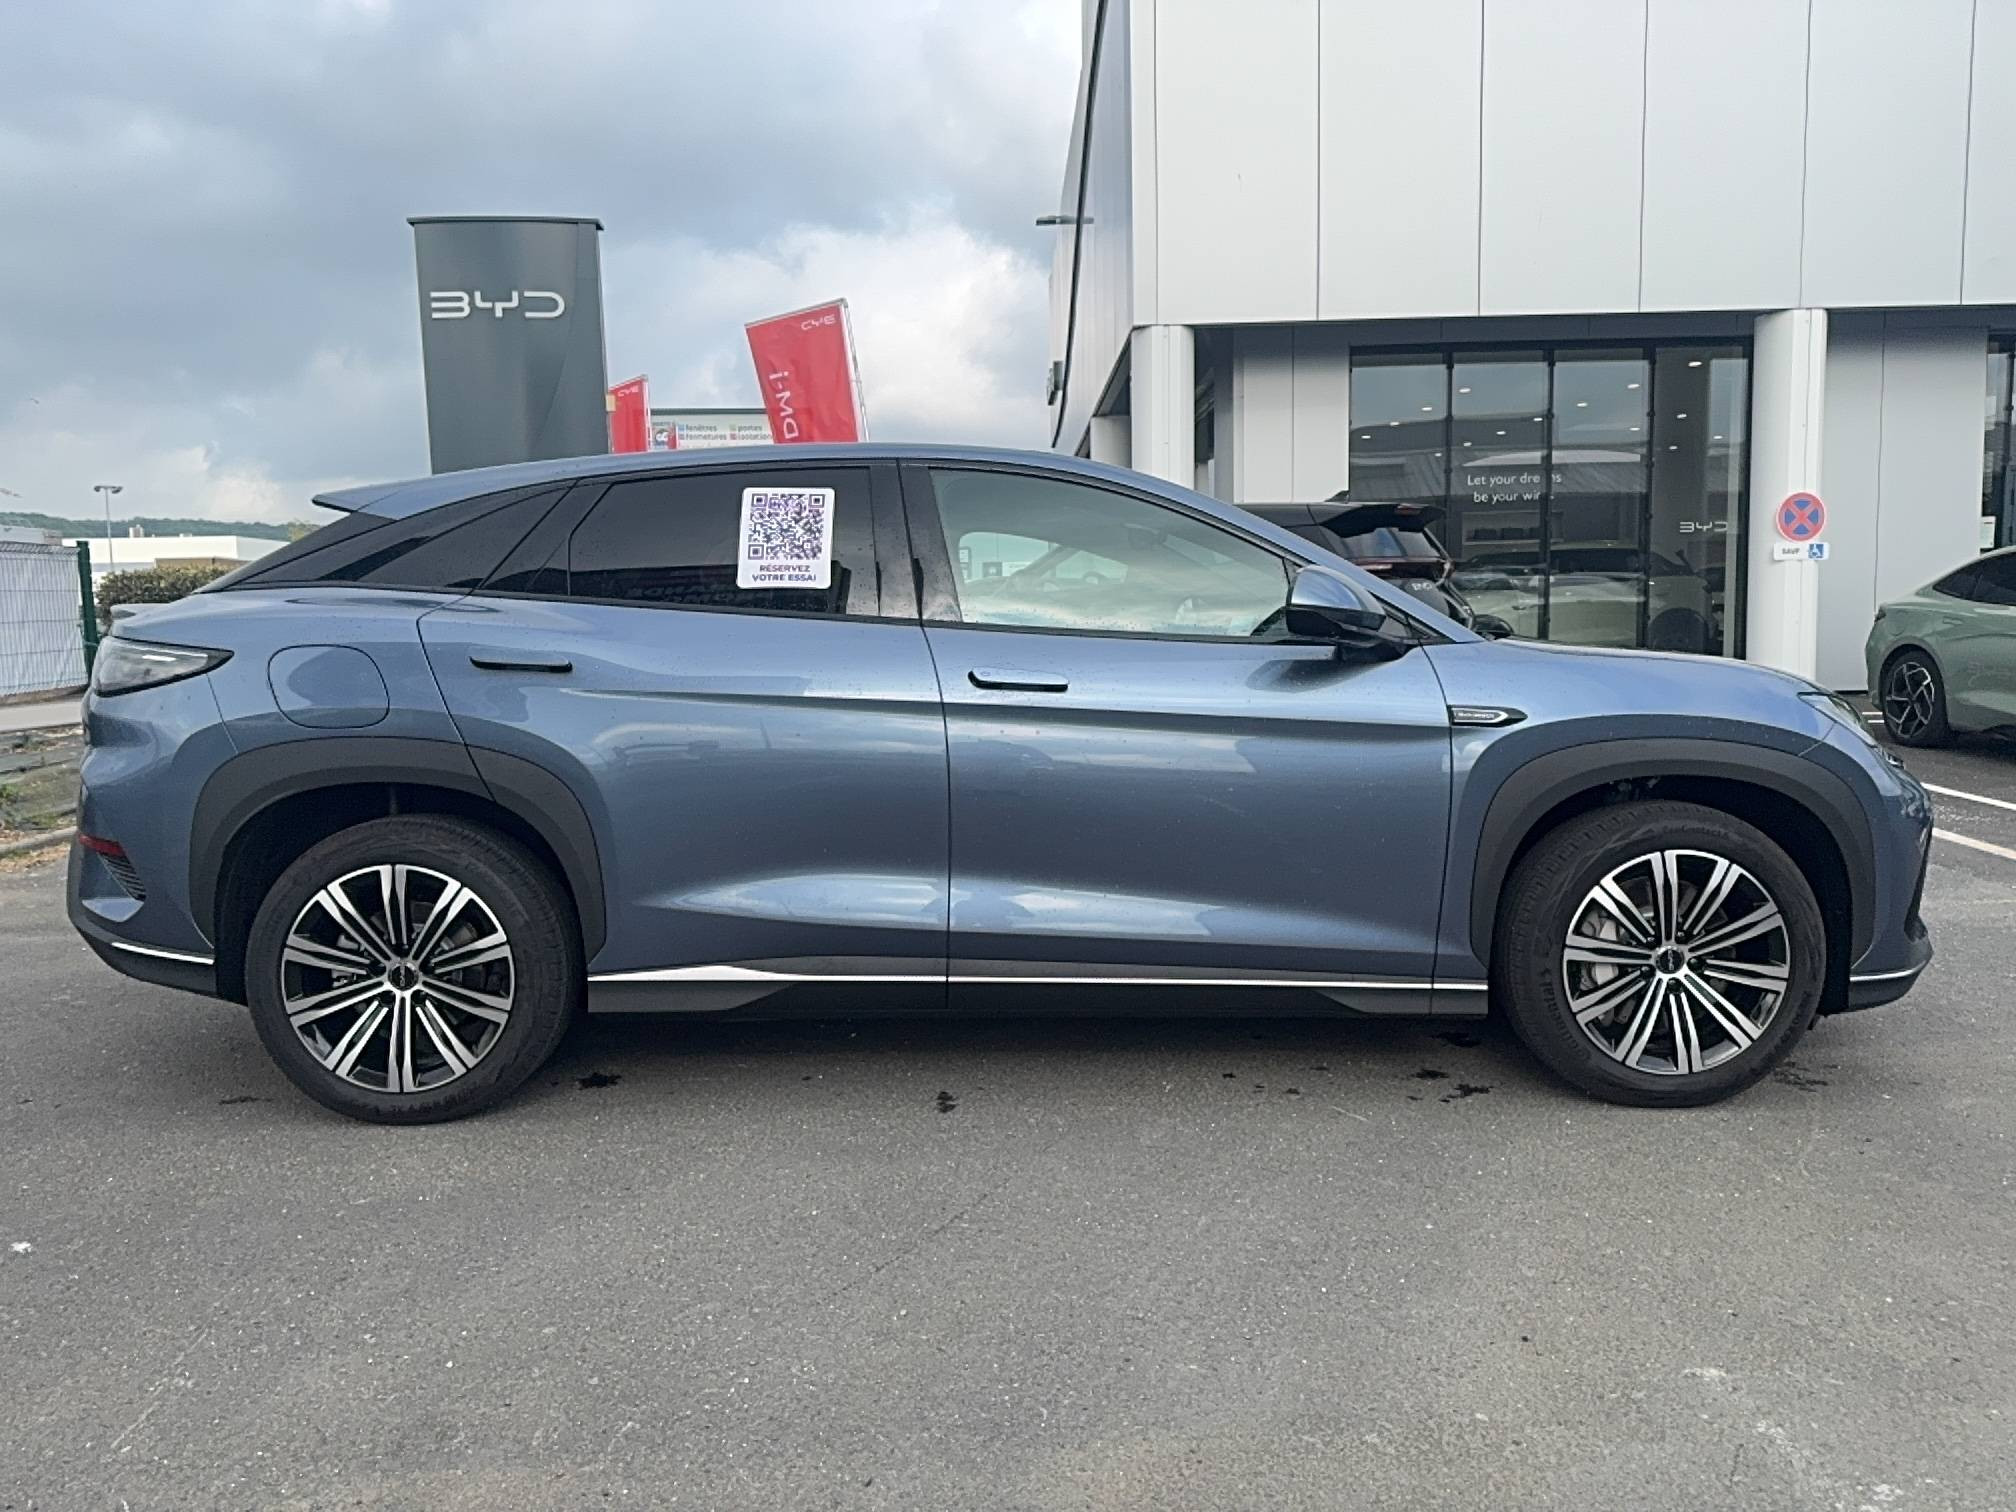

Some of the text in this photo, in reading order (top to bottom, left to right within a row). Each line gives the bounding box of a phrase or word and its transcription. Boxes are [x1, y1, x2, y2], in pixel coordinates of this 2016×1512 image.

[430, 290, 566, 319] BYD
[1467, 474, 1487, 486] Let
[1489, 475, 1517, 488] your
[1473, 491, 1489, 503] be
[1491, 492, 1519, 505] your
[1679, 521, 1729, 533] BYD
[751, 573, 817, 583] VOTRE ESSAI
